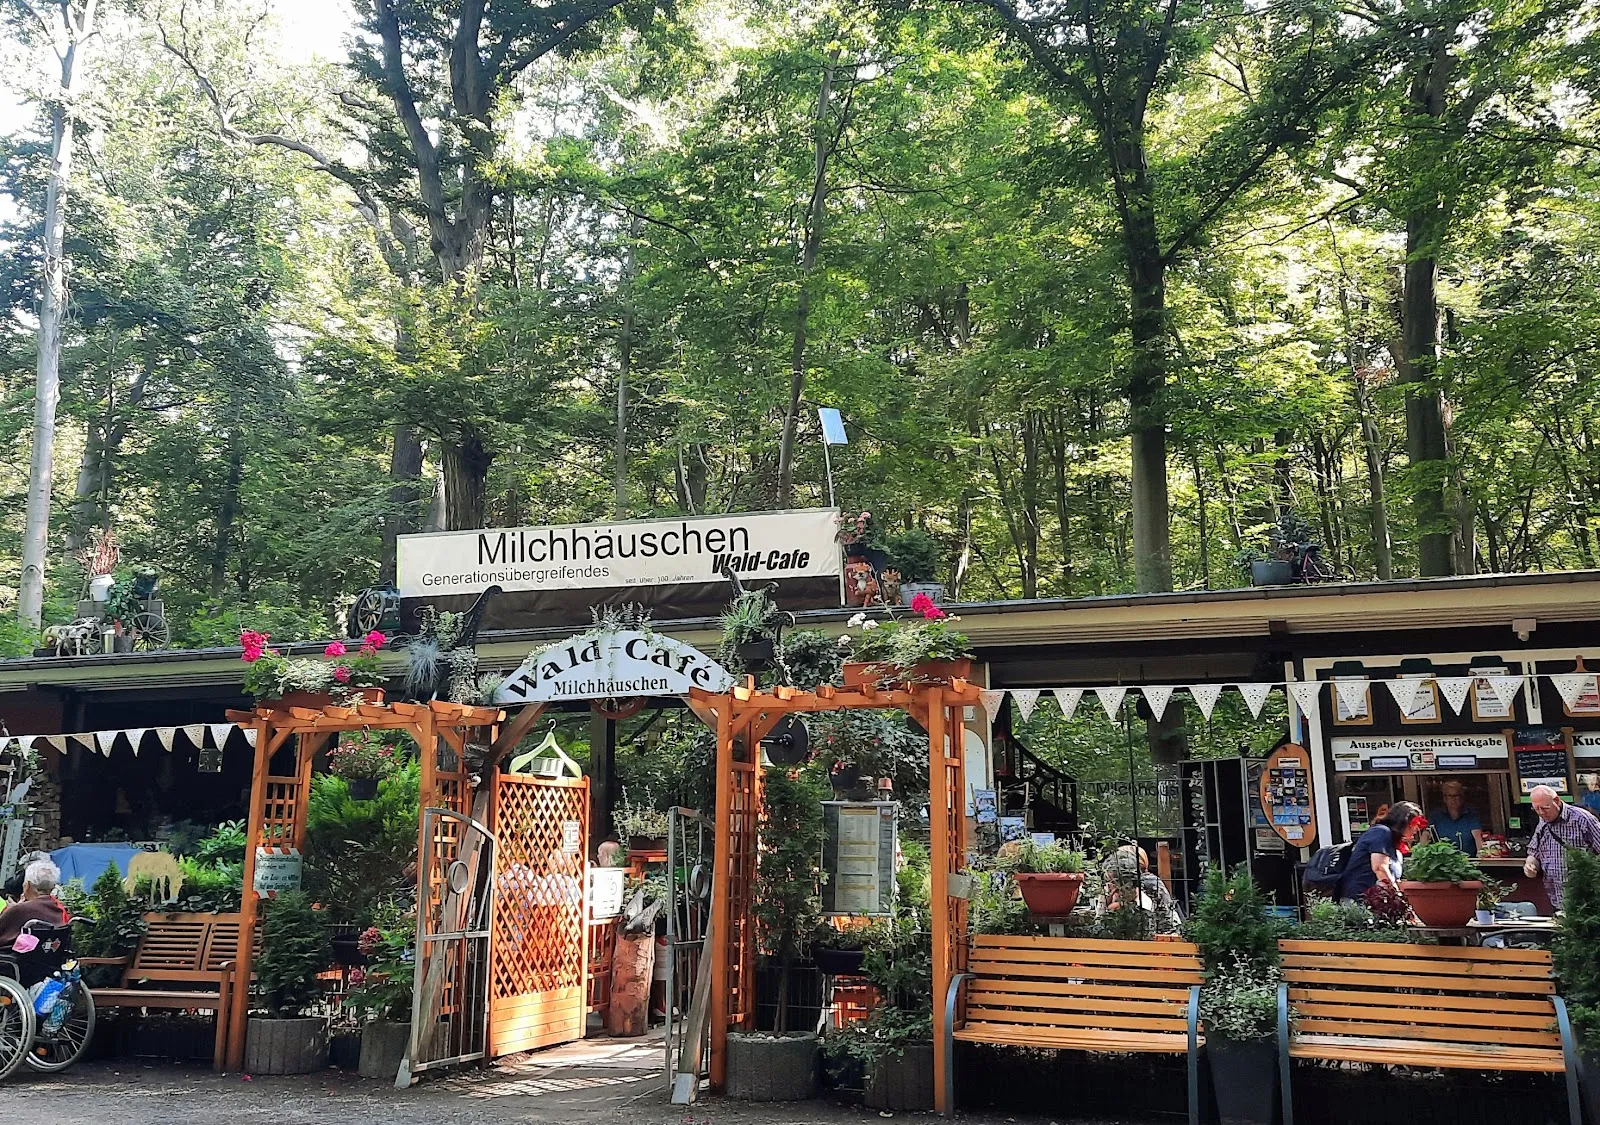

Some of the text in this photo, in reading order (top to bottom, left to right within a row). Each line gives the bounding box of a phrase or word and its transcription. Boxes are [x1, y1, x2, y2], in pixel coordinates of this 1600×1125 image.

[478, 522, 749, 565] Milchhäuschen
[711, 549, 810, 574] Wald-Cafe
[422, 564, 610, 586] Generationsübergreifendes
[672, 574, 694, 582] Jahren
[553, 677, 668, 696] Milchhäuschen
[1404, 737, 1502, 748] Geschirrückgabe
